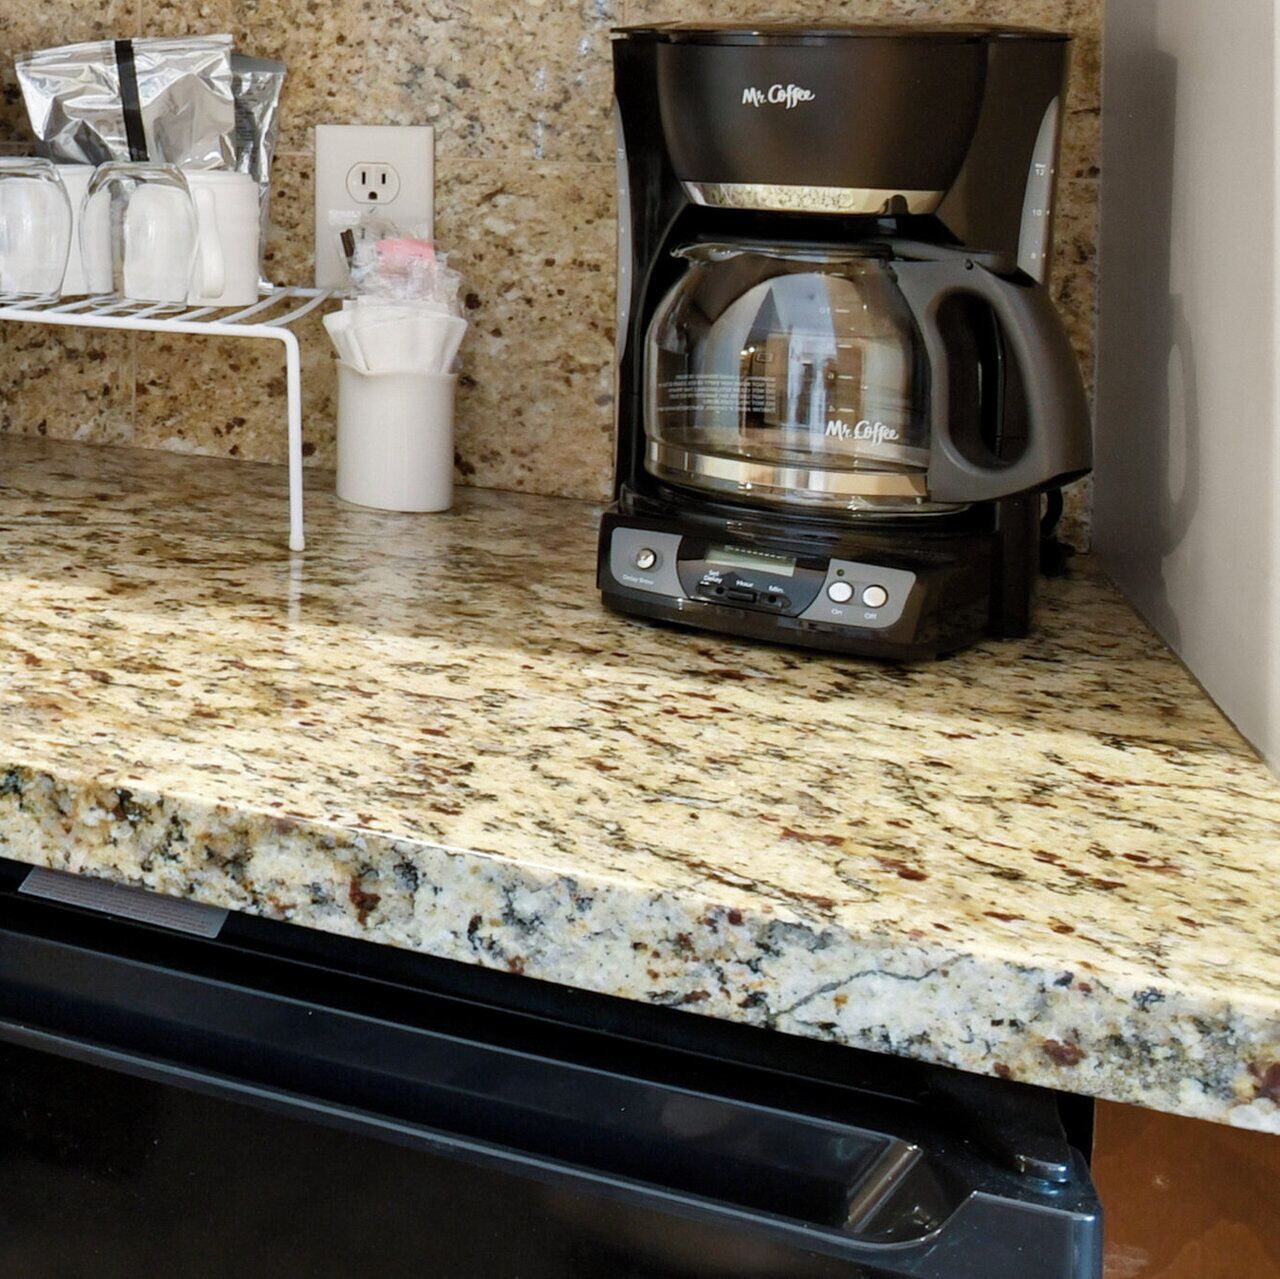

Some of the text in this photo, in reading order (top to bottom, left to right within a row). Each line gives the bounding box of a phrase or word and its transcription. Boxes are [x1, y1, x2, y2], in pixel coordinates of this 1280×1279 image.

[742, 83, 816, 110] Mr. Coffee
[825, 419, 900, 447] Mr. Coffee
[703, 574, 723, 585] Delay
[735, 579, 755, 588] Hour
[831, 607, 843, 616] On
[863, 612, 878, 620] Off
